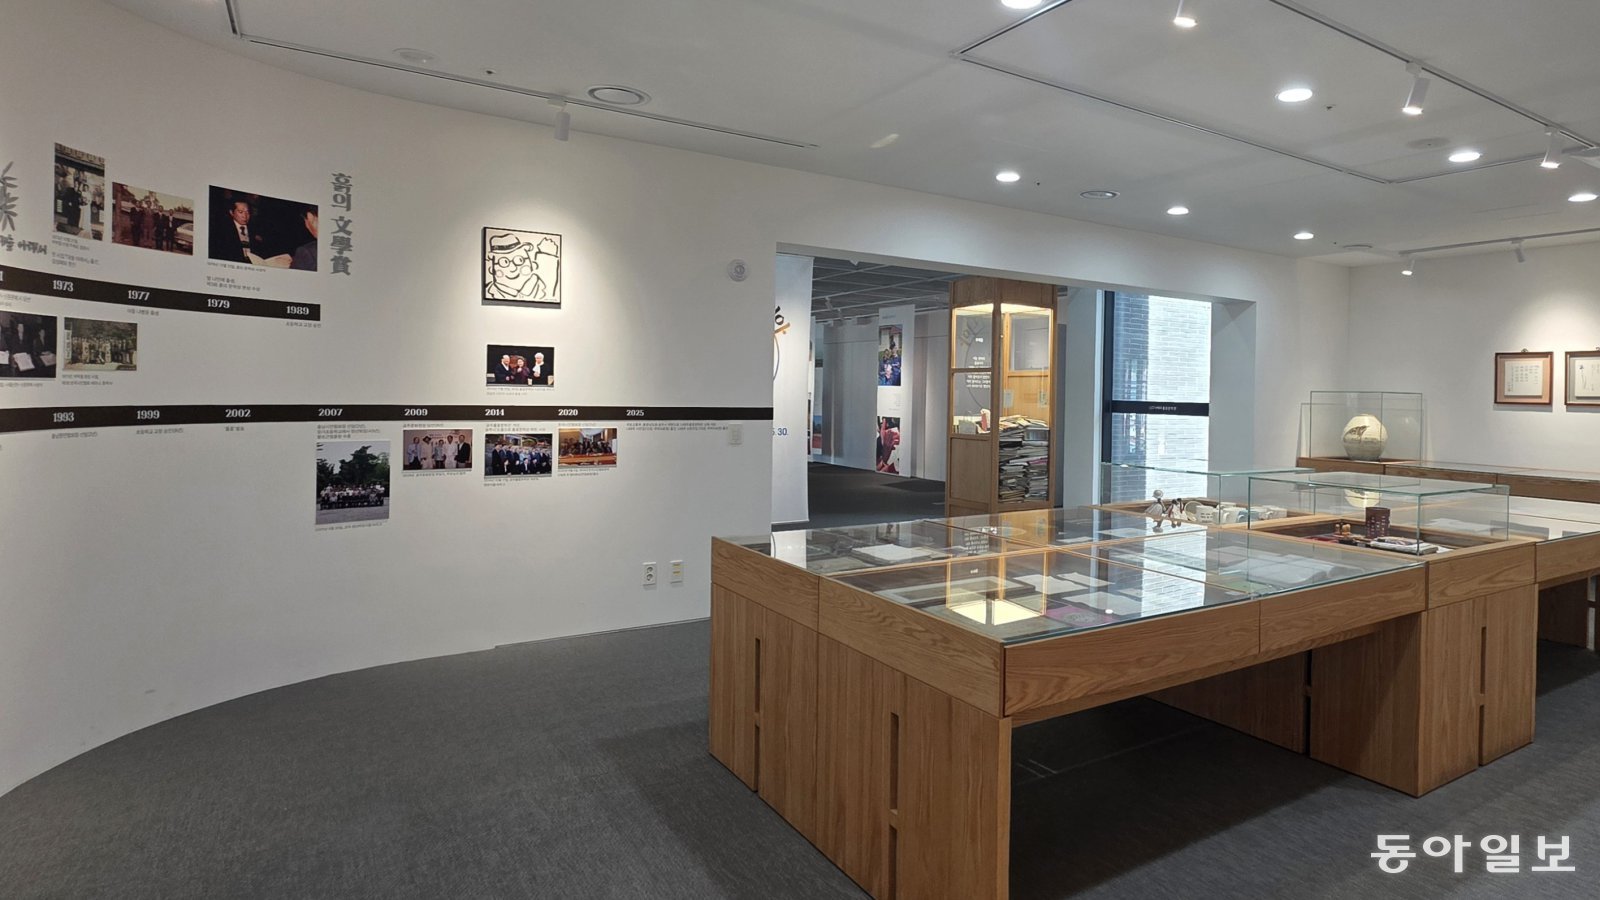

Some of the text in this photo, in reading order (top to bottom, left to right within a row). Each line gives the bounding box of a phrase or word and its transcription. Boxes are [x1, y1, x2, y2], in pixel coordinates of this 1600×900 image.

[330, 172, 352, 212] 흙의
[52, 280, 74, 292] 1973
[127, 290, 150, 301] 1977
[206, 298, 230, 309] 1979
[286, 305, 310, 316] 1989
[136, 410, 160, 420] 1999
[225, 408, 251, 418] 2002
[318, 408, 343, 417] 2007
[404, 408, 428, 417] 2009
[484, 408, 505, 416] 2014
[558, 408, 579, 416] 2020
[626, 409, 645, 417] 2025
[53, 412, 75, 423] 1993
